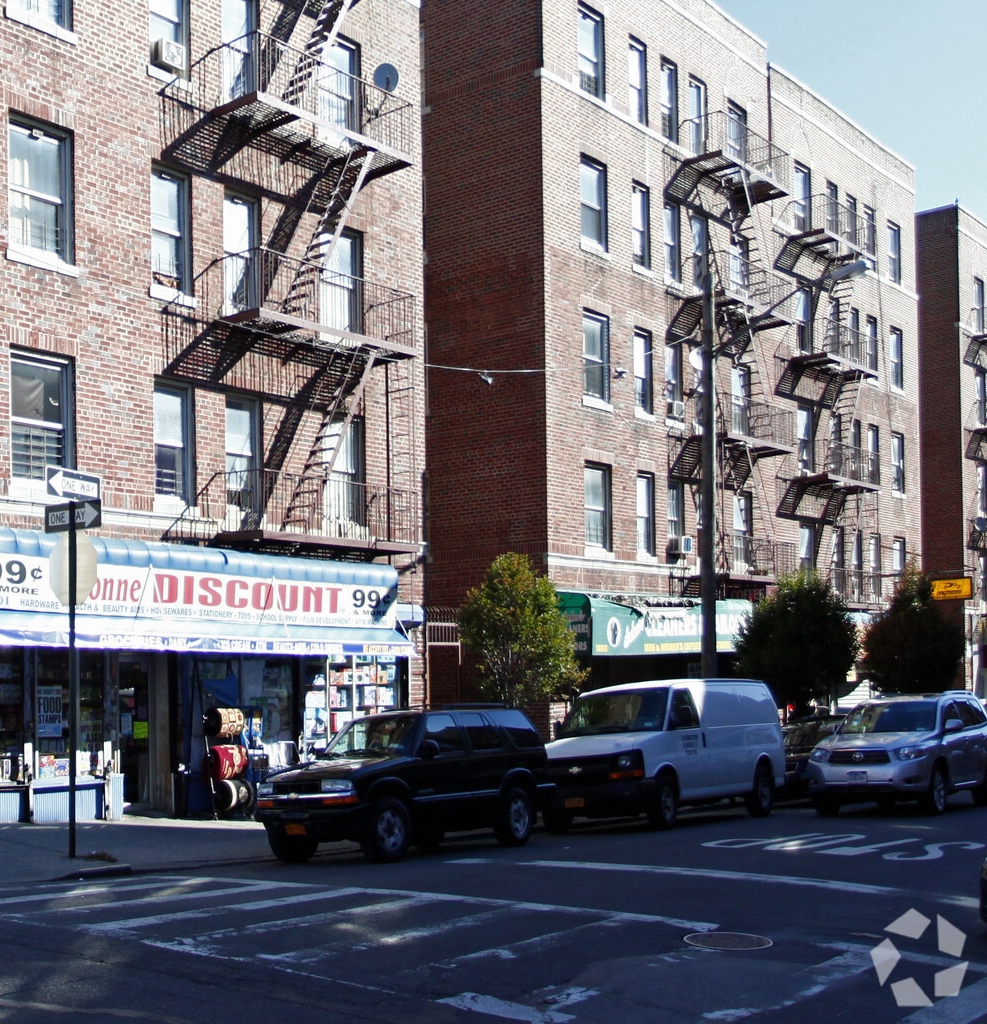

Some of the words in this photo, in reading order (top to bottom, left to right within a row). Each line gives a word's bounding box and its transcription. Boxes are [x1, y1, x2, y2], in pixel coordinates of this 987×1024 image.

[61, 478, 76, 492] ONE
[80, 482, 95, 494] WAY
[50, 512, 66, 525] ONE
[73, 509, 86, 522] AY
[0, 585, 39, 596] MORE
[89, 576, 142, 603] onne
[153, 573, 343, 614] DISCOUNT
[20, 598, 59, 610] HARDWARE
[103, 605, 128, 614] BEAUTY
[199, 609, 233, 619] STATIONERY
[238, 611, 252, 620] TOYS
[256, 613, 278, 622] SCHOOL
[317, 617, 353, 625] DEVELOPMENT
[362, 609, 387, 617] MORE
[99, 634, 163, 648] GROCERIES
[37, 696, 62, 714] FOOD
[37, 714, 62, 724] STAMPS
[700, 832, 986, 861] STOP
